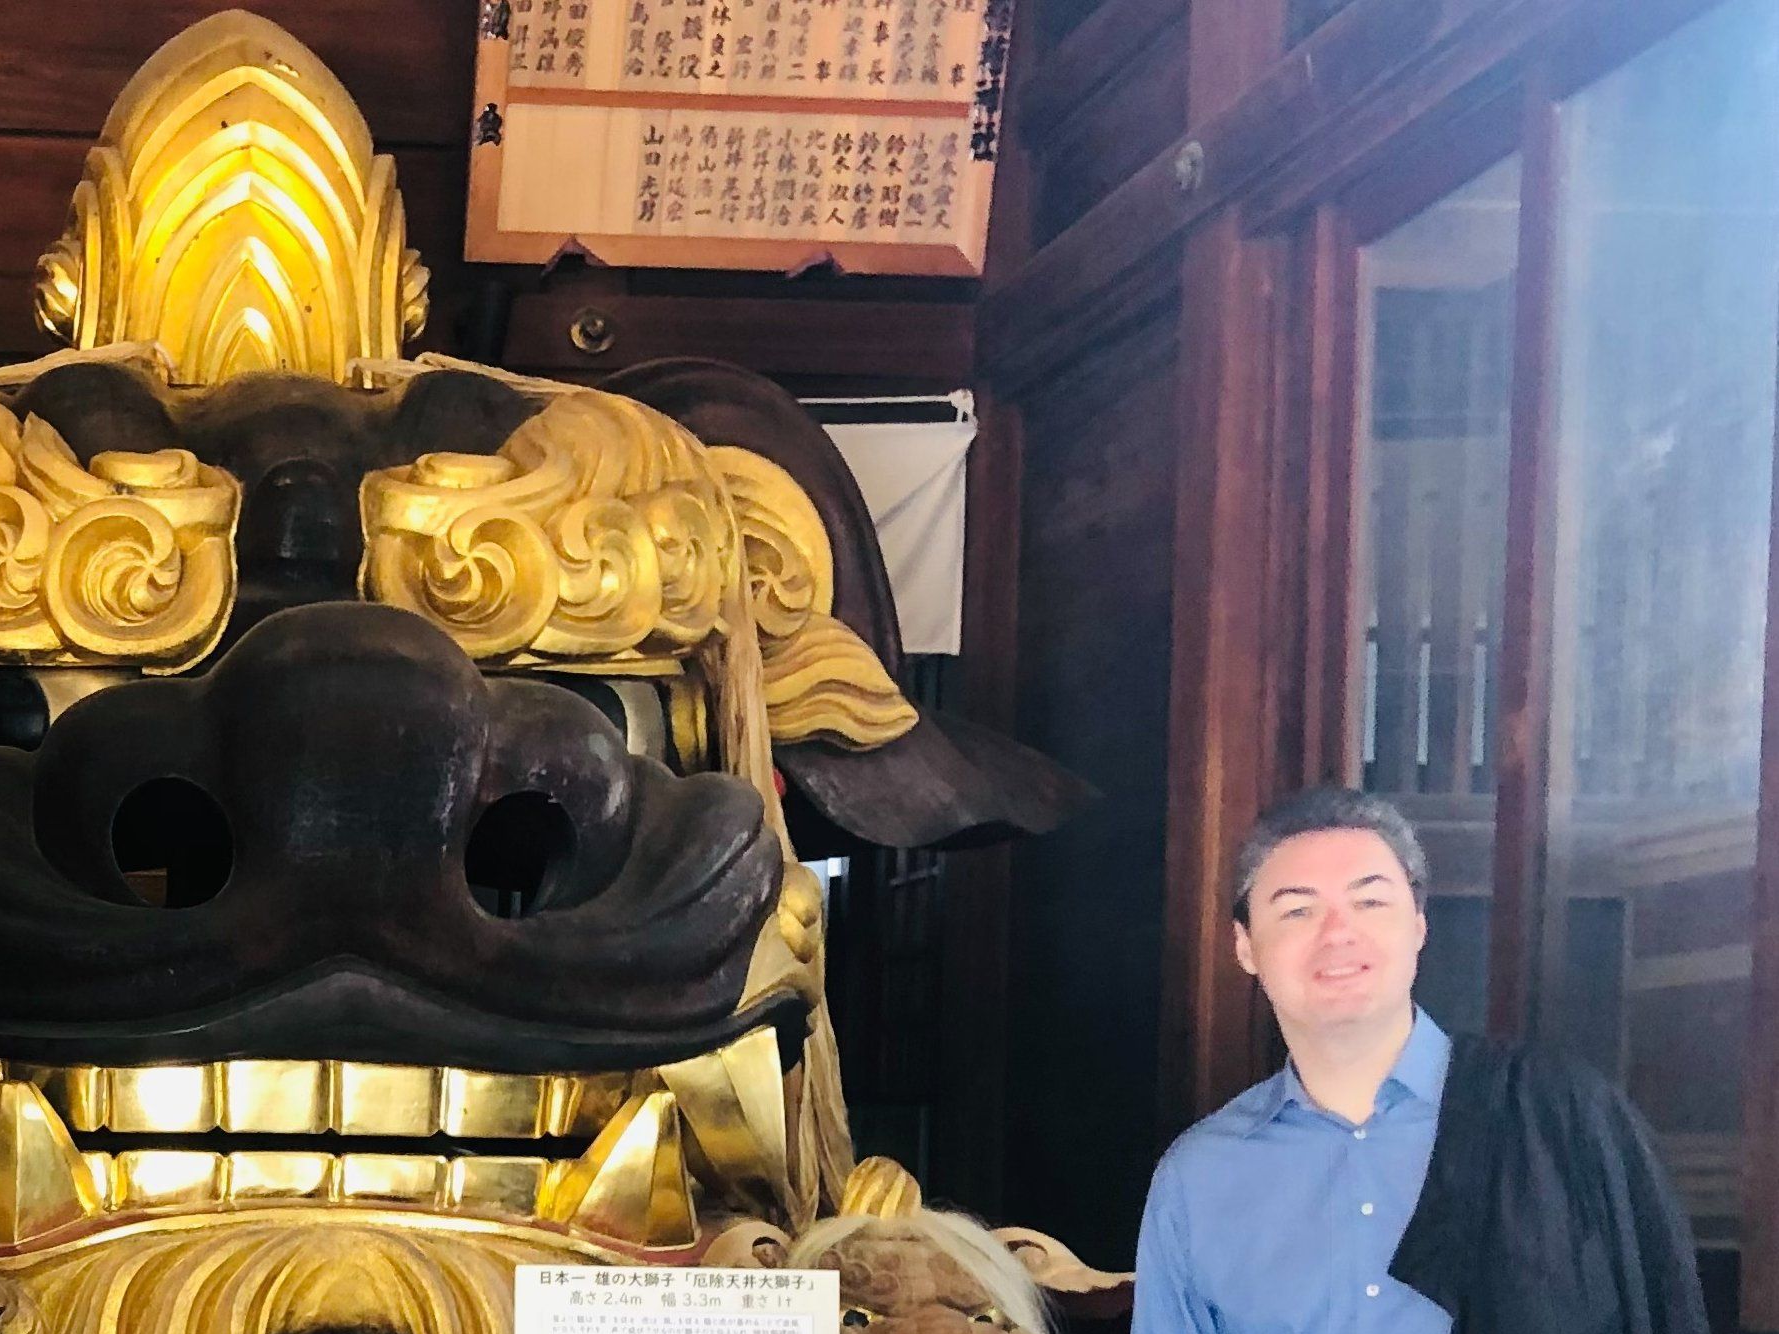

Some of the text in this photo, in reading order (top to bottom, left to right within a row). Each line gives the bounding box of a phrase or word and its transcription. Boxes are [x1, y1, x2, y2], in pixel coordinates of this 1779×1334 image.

[679, 0, 703, 80] 談役
[539, 1270, 586, 1286] 日本一
